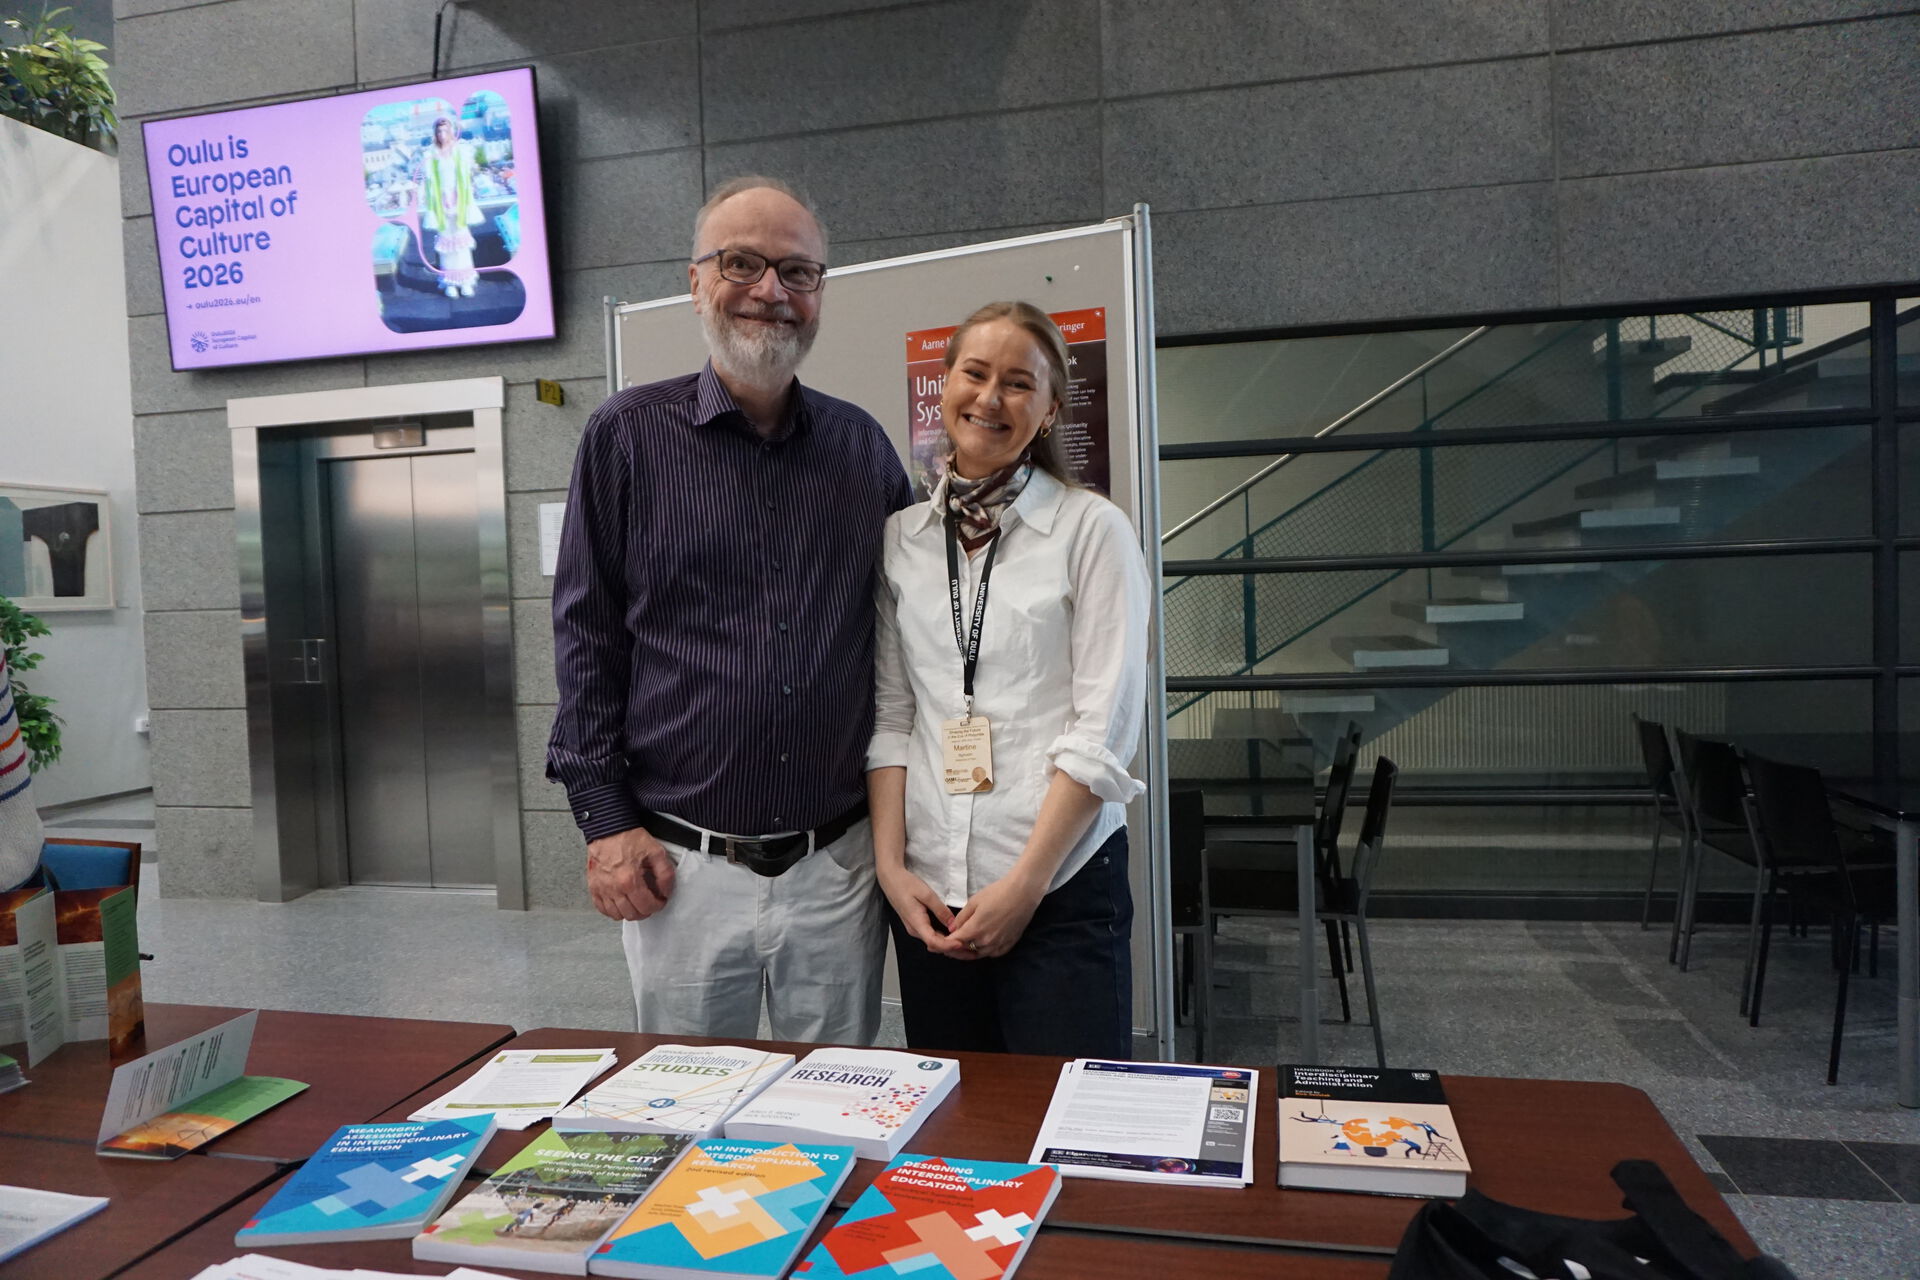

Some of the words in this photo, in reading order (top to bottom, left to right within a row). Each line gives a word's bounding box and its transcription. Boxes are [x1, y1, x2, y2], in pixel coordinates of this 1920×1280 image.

[168, 139, 223, 167] Oulu
[228, 134, 249, 159] is
[171, 165, 292, 198] European
[176, 194, 264, 229] Capital
[270, 190, 297, 217] of
[179, 230, 271, 259] Culture
[183, 261, 243, 289] 2026
[921, 339, 945, 351] Aarne
[951, 579, 959, 599] OULU
[973, 582, 987, 628] UNIVERSITY
[971, 629, 979, 640] OF
[968, 640, 978, 661] OULU
[633, 1063, 734, 1077] STUDIES
[1294, 1070, 1380, 1081] Interdisciplinary
[790, 1069, 890, 1088] RESEARCH
[1294, 1075, 1341, 1083] Teaching
[1294, 1080, 1374, 1088] Administration
[341, 1131, 421, 1140] ASSESSMENT
[347, 1125, 425, 1134] MEANINGFUL
[352, 1131, 469, 1146] INTERDISCIPLINARY
[330, 1144, 402, 1153] EDUCATION
[534, 1148, 591, 1160] SEEING
[594, 1153, 624, 1162] THE
[626, 1155, 663, 1164] CITY
[724, 1145, 820, 1159] INTRODUCTION
[822, 1153, 839, 1161] TO
[691, 1159, 756, 1171] RESEARCH
[697, 1152, 819, 1167] INTERDISCIPLINARY
[571, 1168, 594, 1176] Study
[903, 1160, 974, 1175] DESIGNING
[890, 1175, 967, 1192] EDUCATION
[896, 1168, 1024, 1189] INTERDISCIPLINARY
